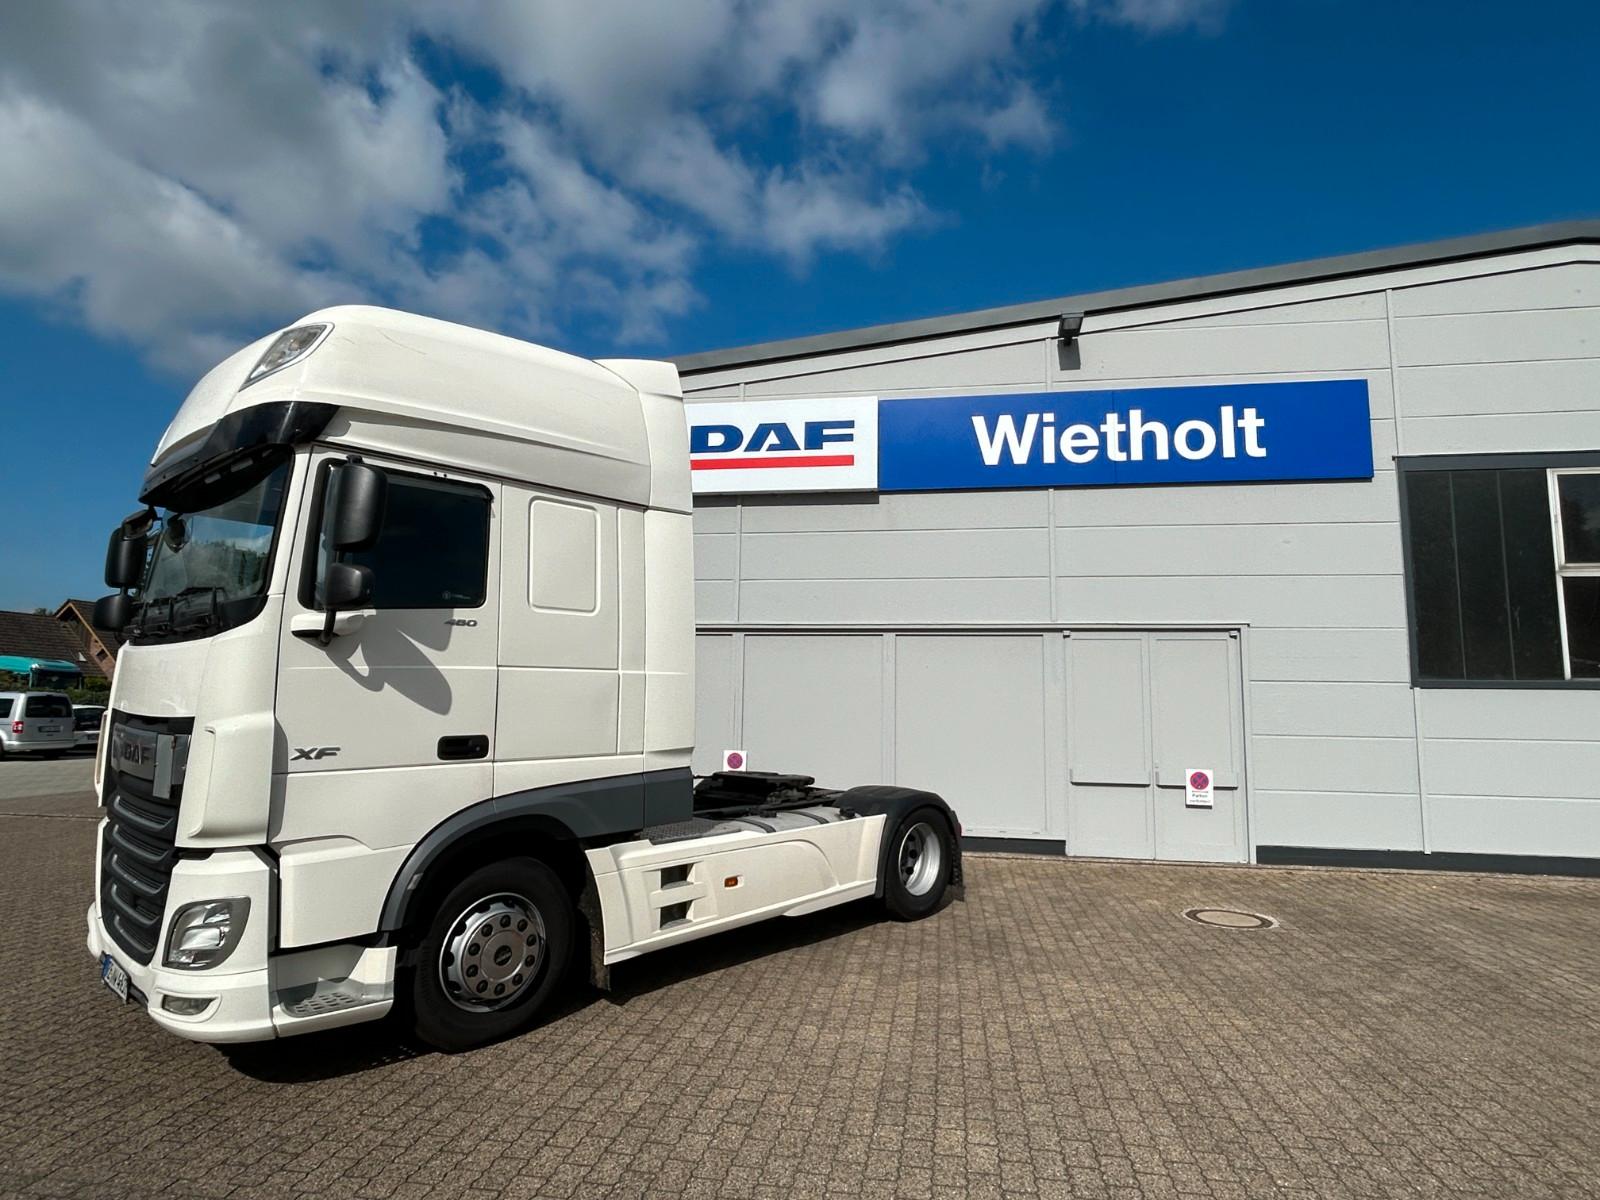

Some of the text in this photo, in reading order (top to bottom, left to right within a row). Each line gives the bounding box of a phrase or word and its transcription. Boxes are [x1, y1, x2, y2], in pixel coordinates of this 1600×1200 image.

[690, 420, 855, 453] DAF
[972, 405, 1267, 466] Wietholt
[444, 618, 477, 627] 480
[290, 746, 341, 761] XF
